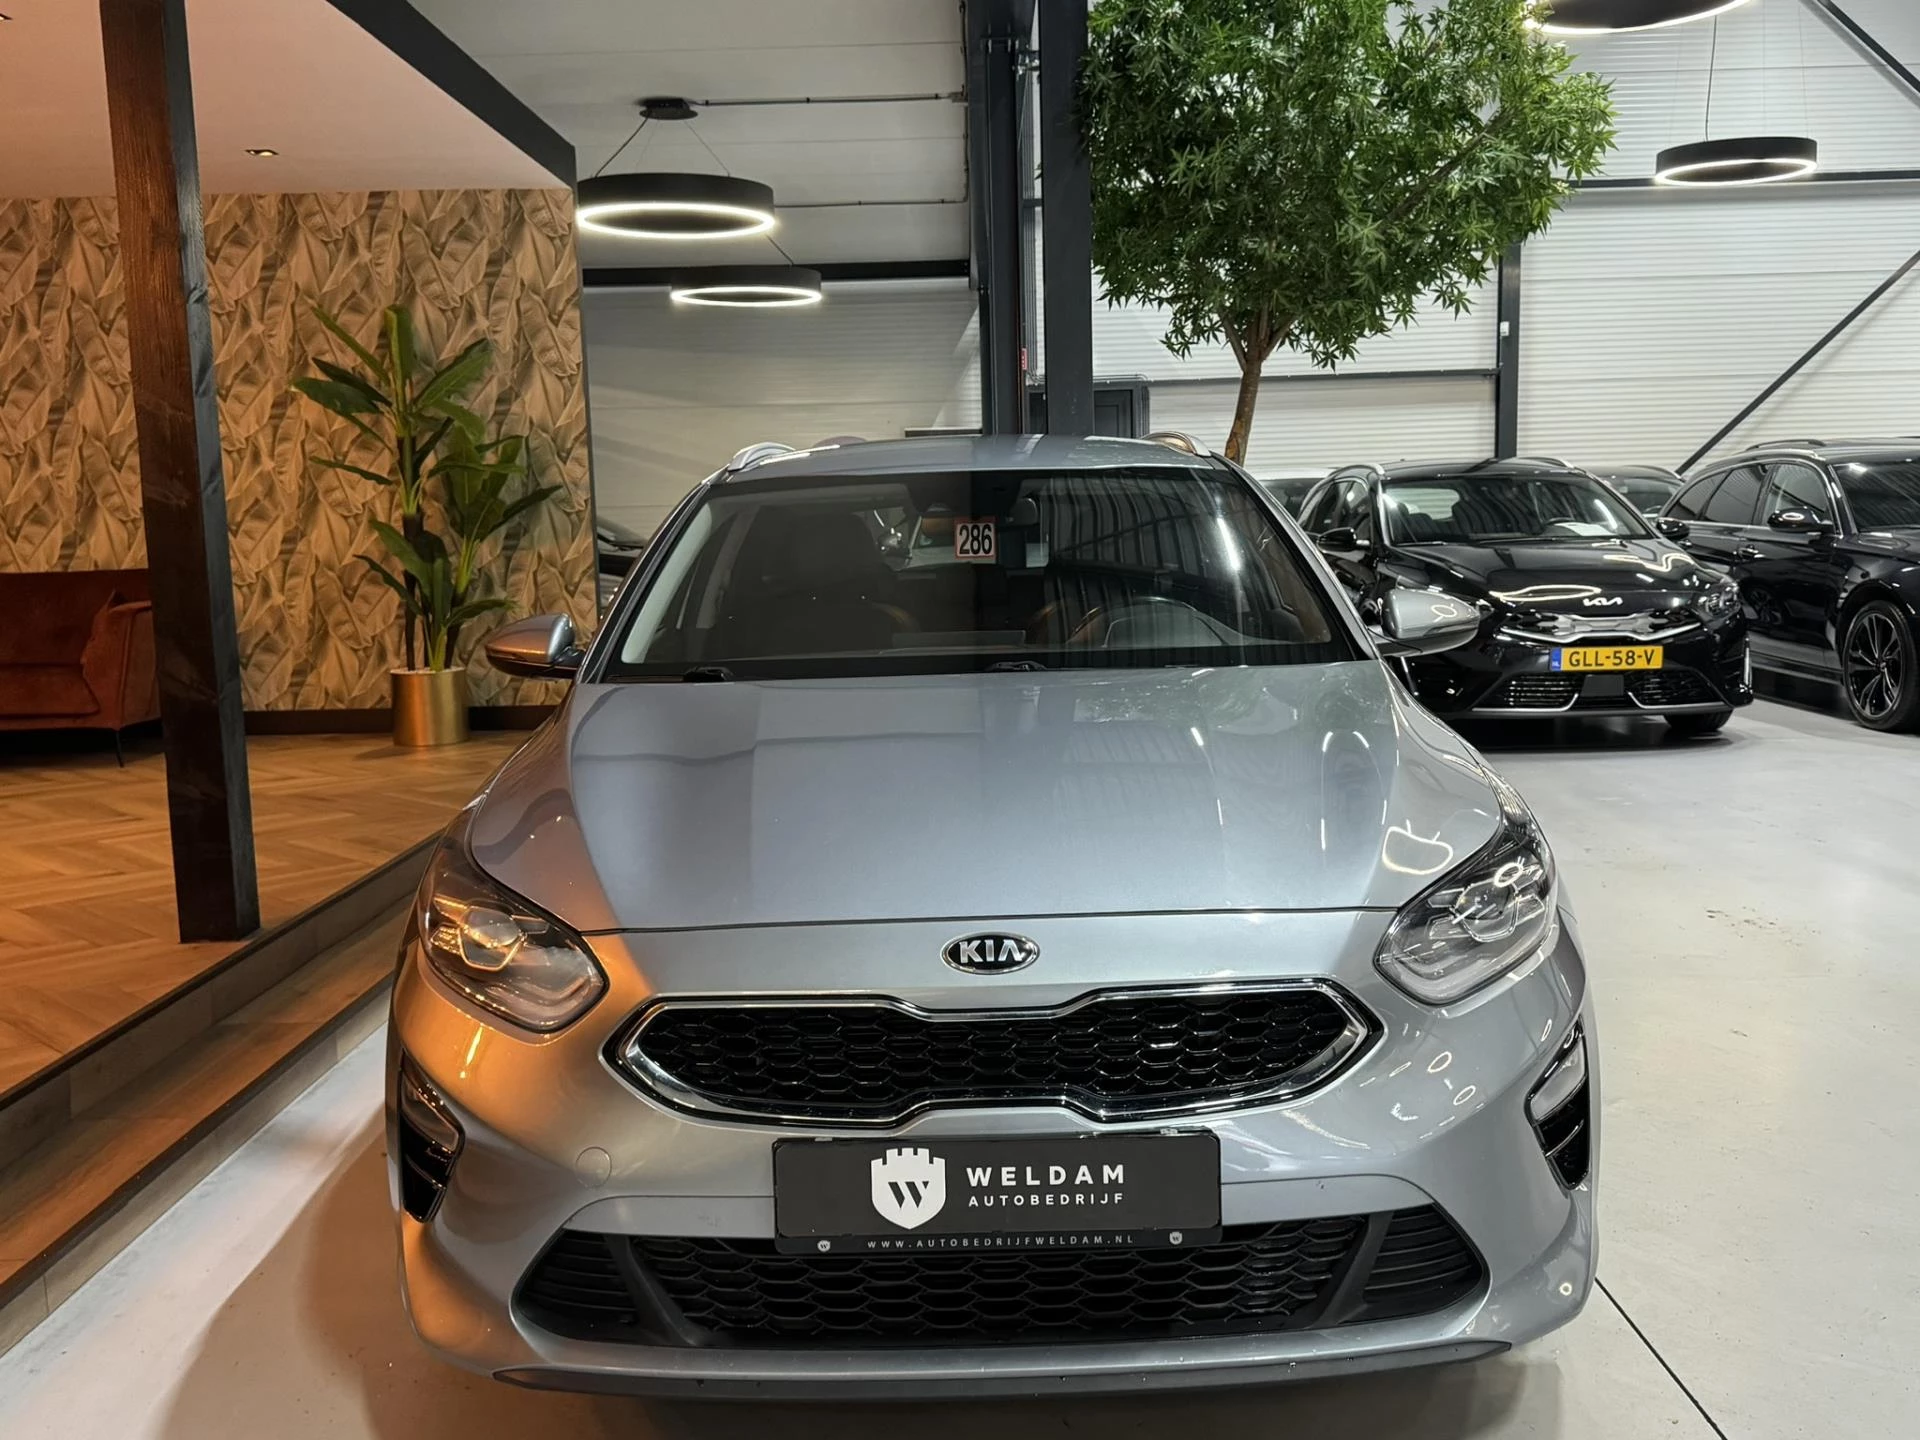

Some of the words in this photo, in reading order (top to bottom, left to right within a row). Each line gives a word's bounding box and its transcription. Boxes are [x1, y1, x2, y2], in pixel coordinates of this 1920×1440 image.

[959, 524, 992, 554] 286
[1569, 649, 1655, 667] GLL-58-V
[959, 939, 1023, 963] KIA
[966, 1164, 1125, 1187] WELDAM
[968, 1192, 1123, 1207] AUTOBEDRIJF
[867, 1235, 1133, 1249] WWW.AUTOBEDRIJFWELDAM.NL
